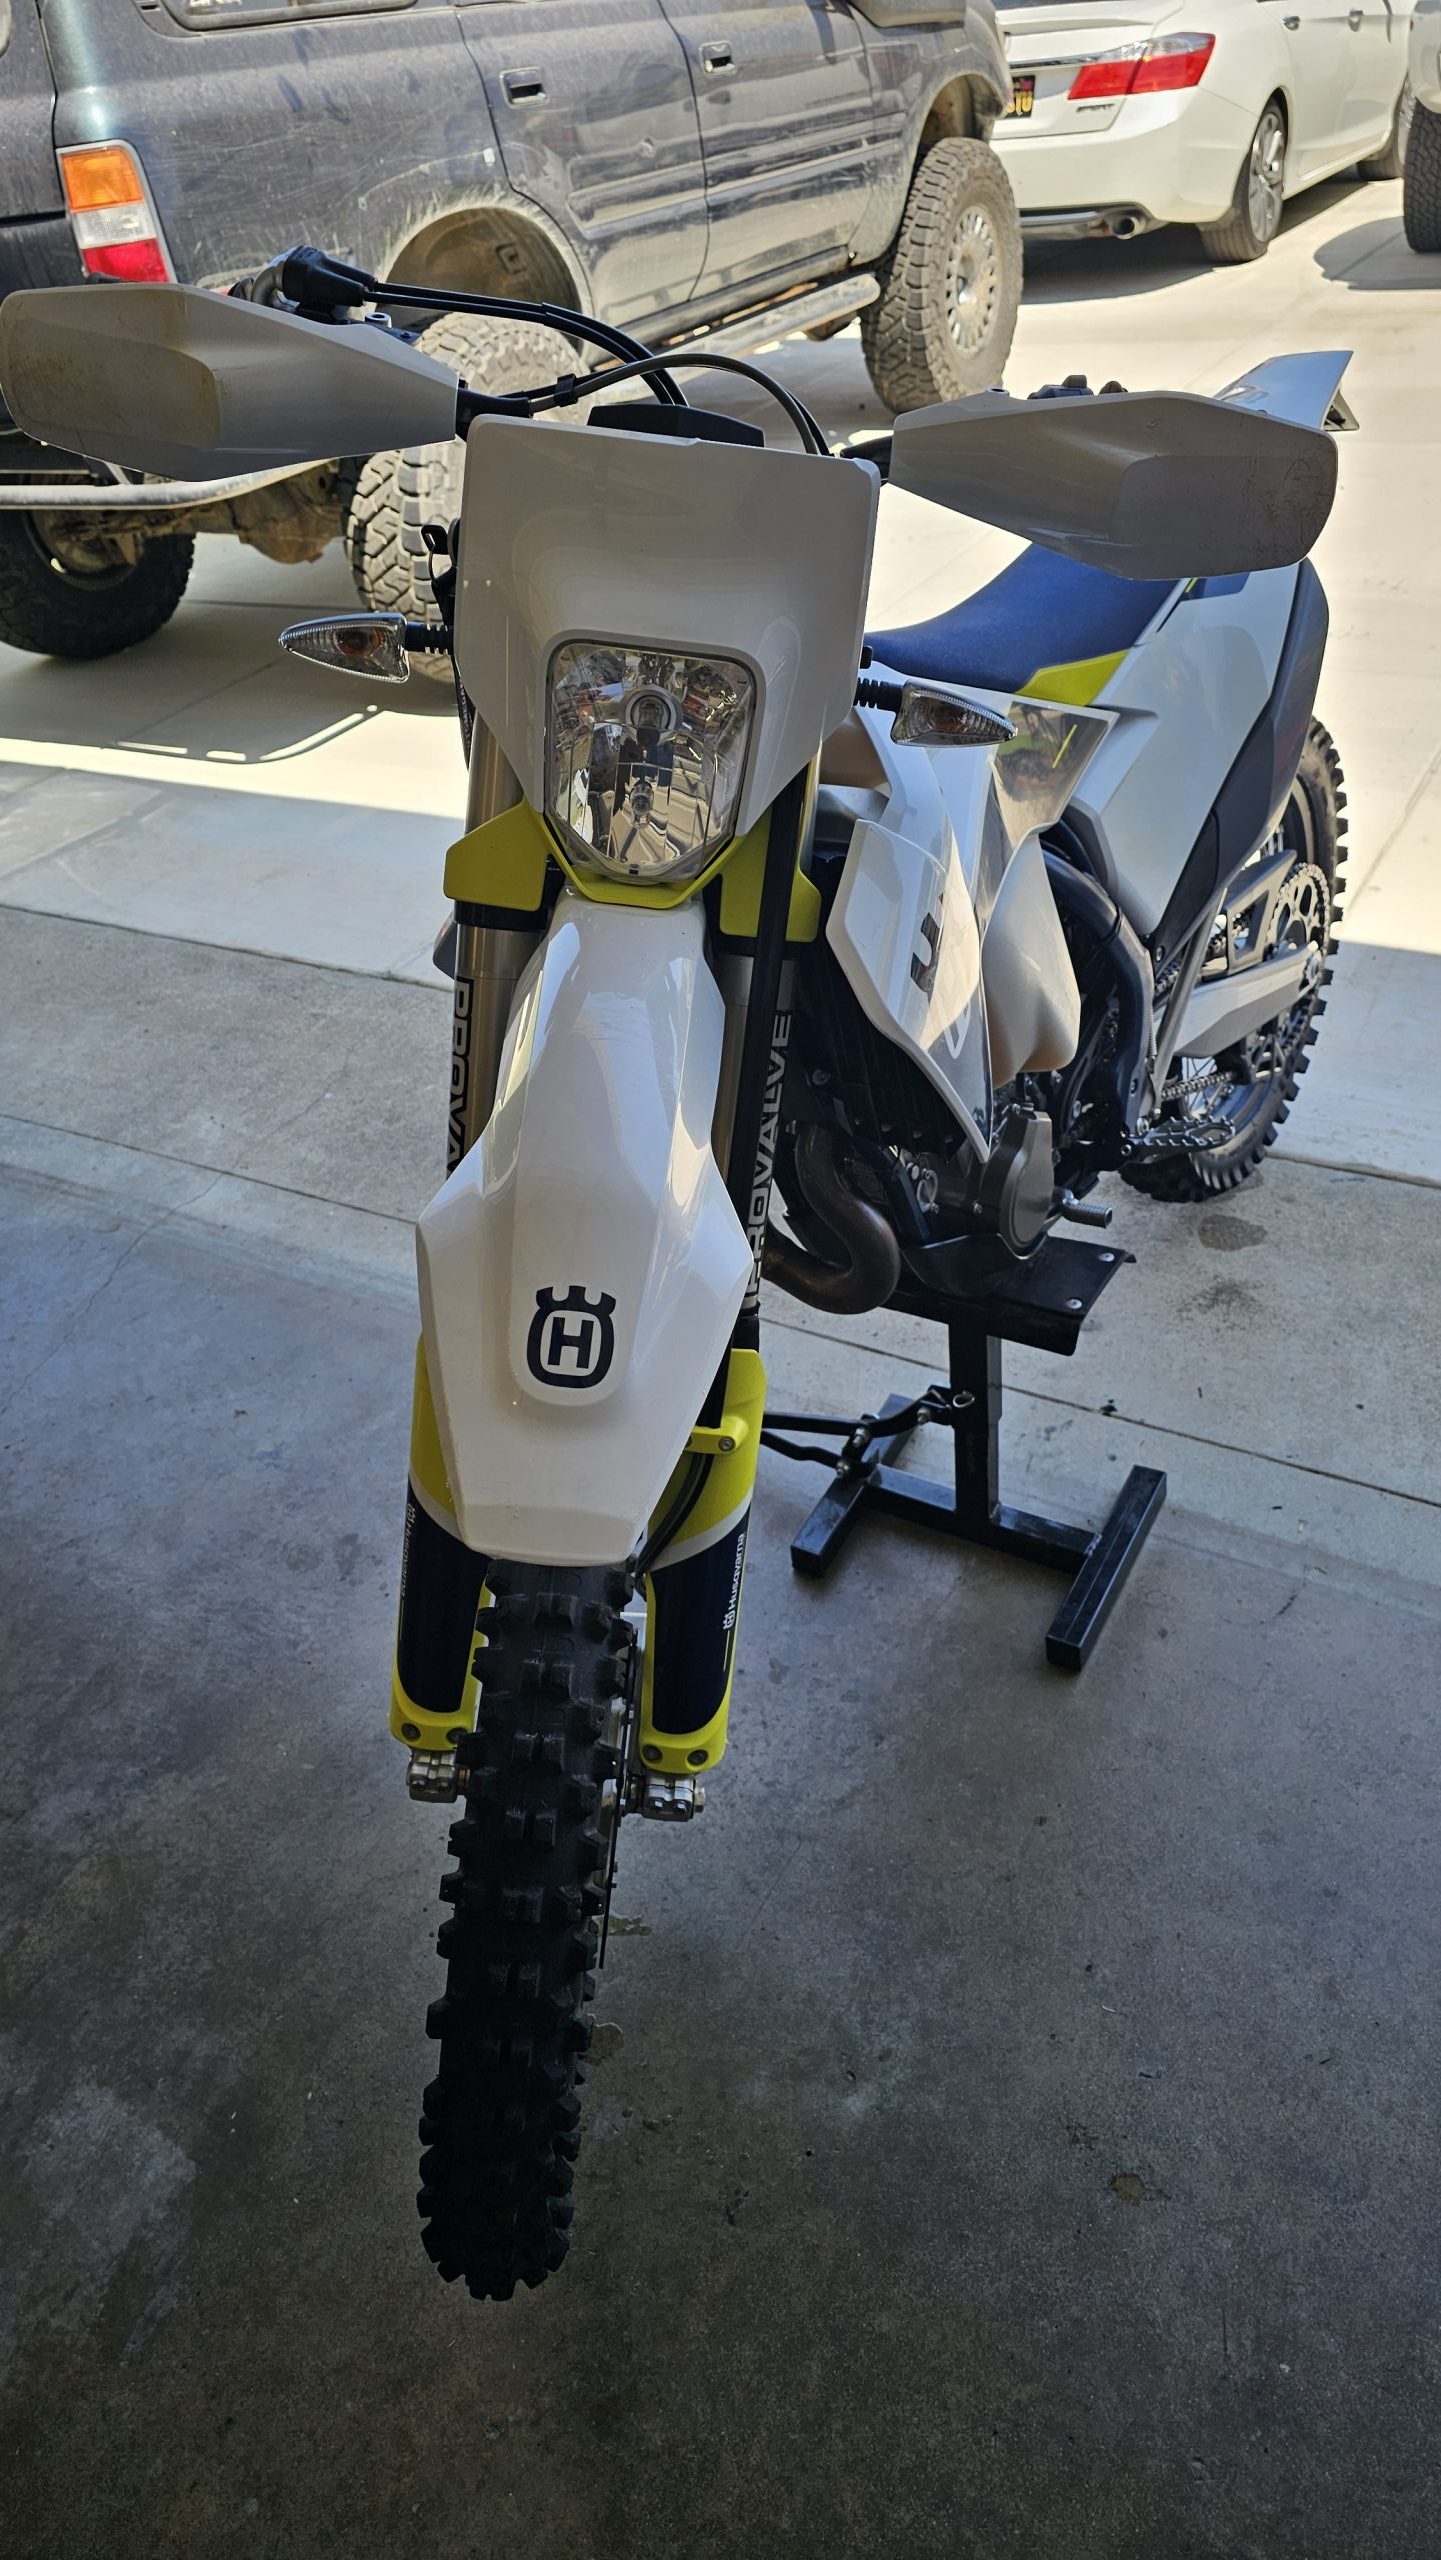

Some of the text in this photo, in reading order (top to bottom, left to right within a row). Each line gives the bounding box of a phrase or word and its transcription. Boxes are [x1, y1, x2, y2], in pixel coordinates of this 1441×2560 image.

[447, 984, 471, 1176] PROVA
[547, 1316, 595, 1369] H
[728, 1533, 745, 1611] Husqvarna
